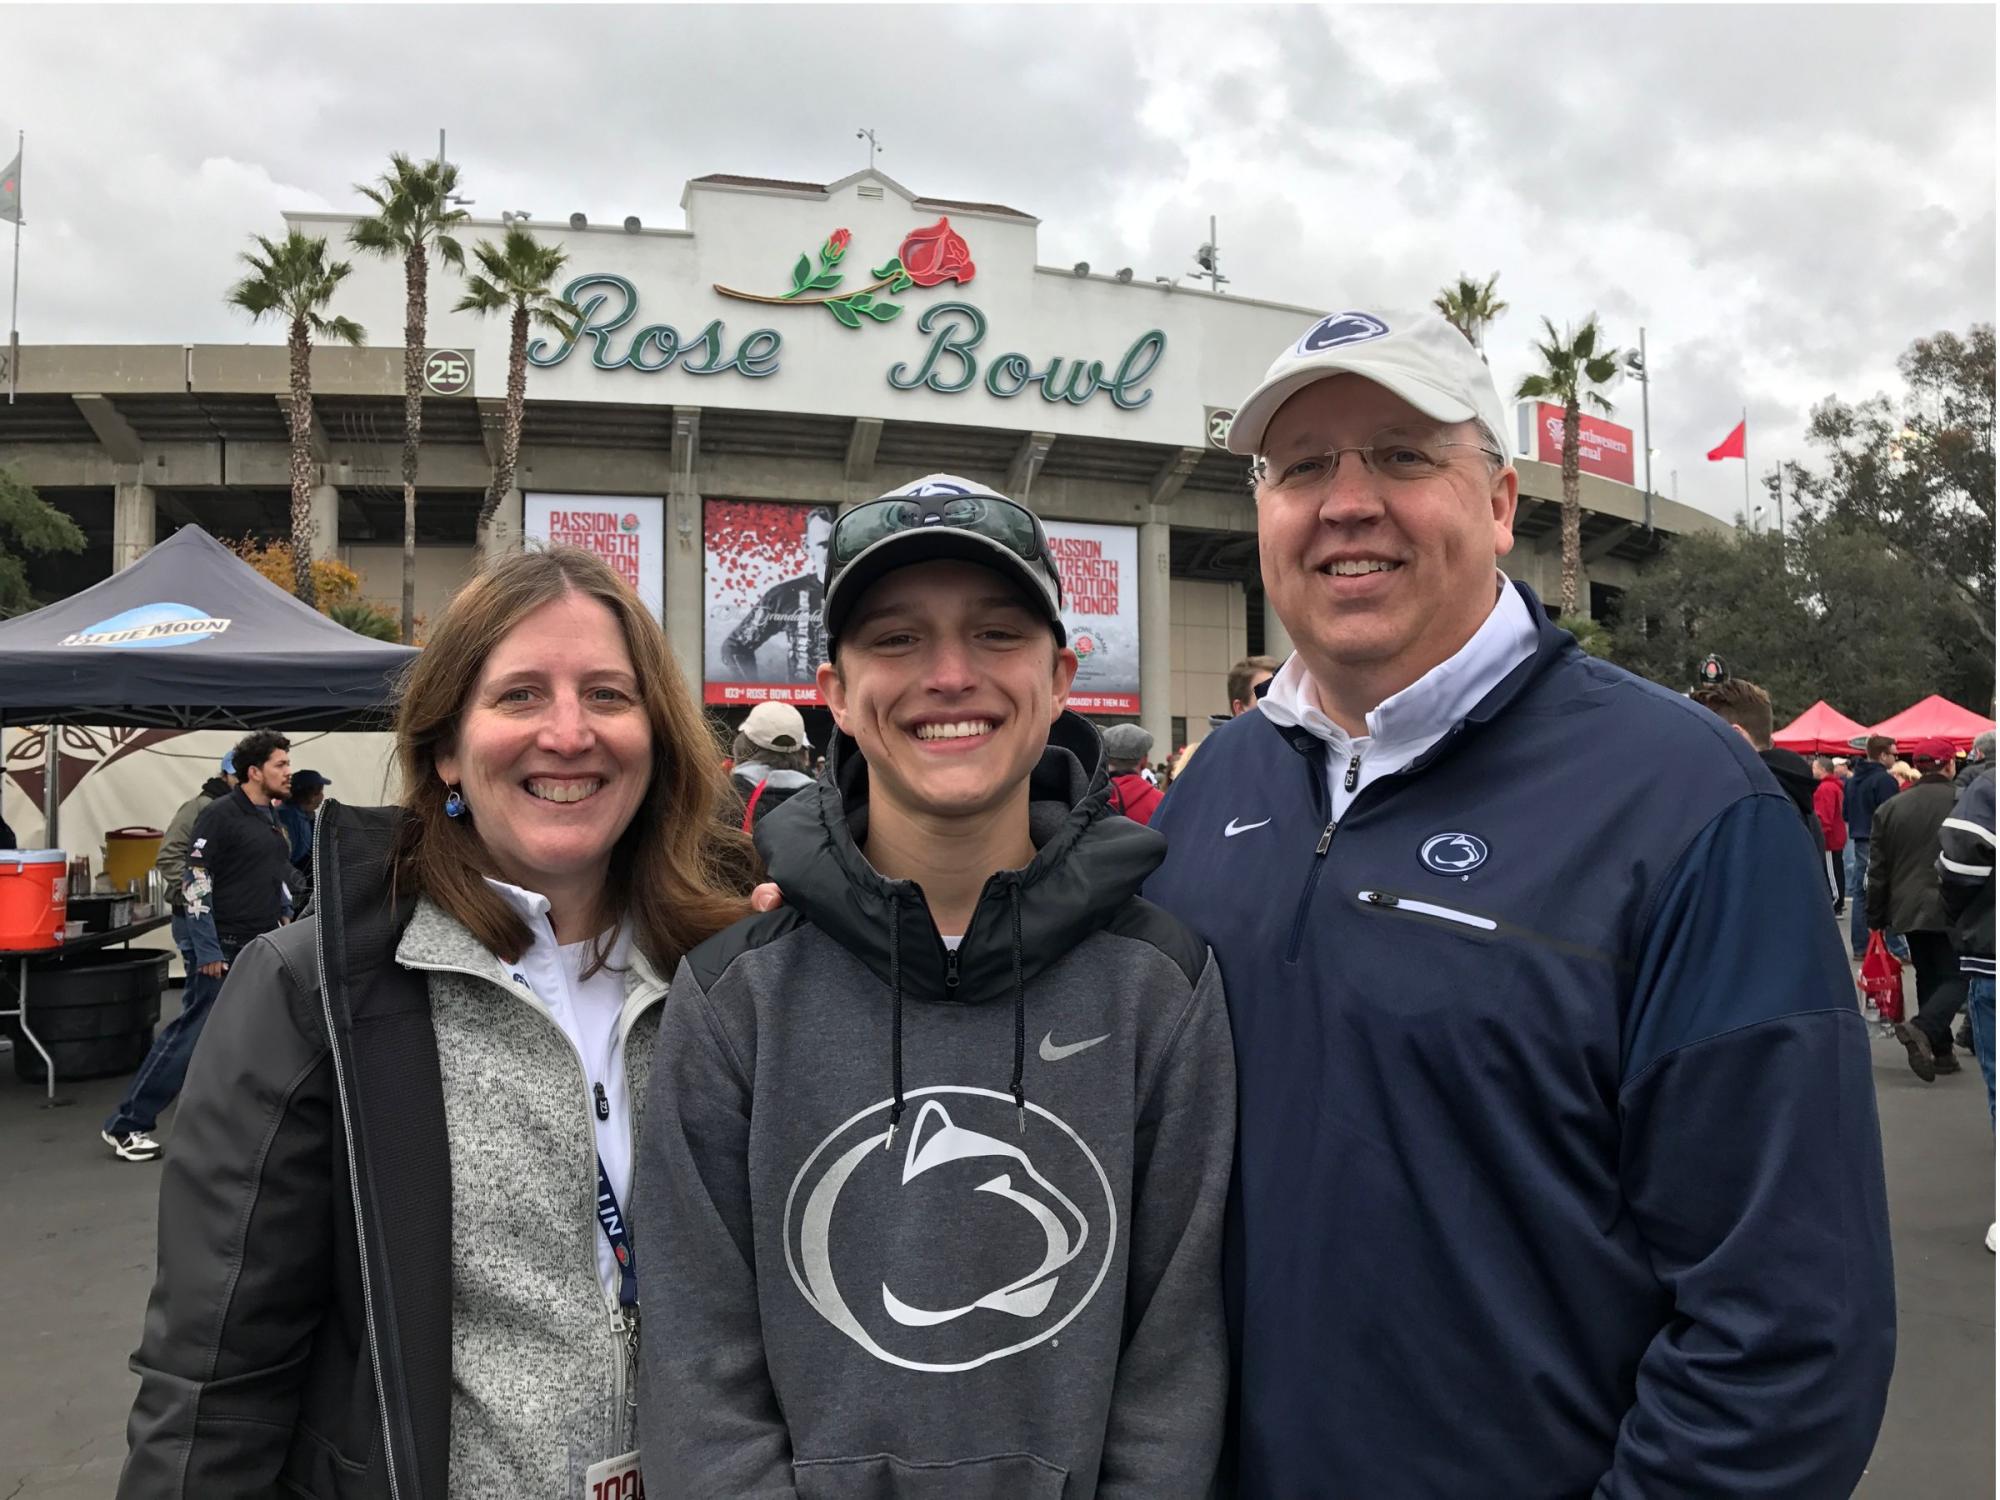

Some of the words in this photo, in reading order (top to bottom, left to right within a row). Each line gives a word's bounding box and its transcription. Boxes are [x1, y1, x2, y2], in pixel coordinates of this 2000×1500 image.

[527, 272, 782, 377] Rose
[887, 301, 1168, 410] Bowl
[429, 359, 465, 384] 25
[1577, 429, 1628, 454] orthwestern
[549, 511, 618, 532] PASSION
[1048, 537, 1102, 558] PASSION
[1056, 557, 1119, 578] TRENGTH
[1060, 576, 1119, 597] RADITION
[1072, 595, 1119, 616] HONOR
[66, 629, 146, 646] BLUE
[149, 619, 225, 636] MOON
[746, 688, 768, 700] ROSE
[769, 689, 793, 700] BOWL
[794, 689, 817, 701] GAME
[1094, 698, 1102, 708] OF
[1102, 698, 1118, 708] THEM
[1119, 699, 1130, 709] ALL
